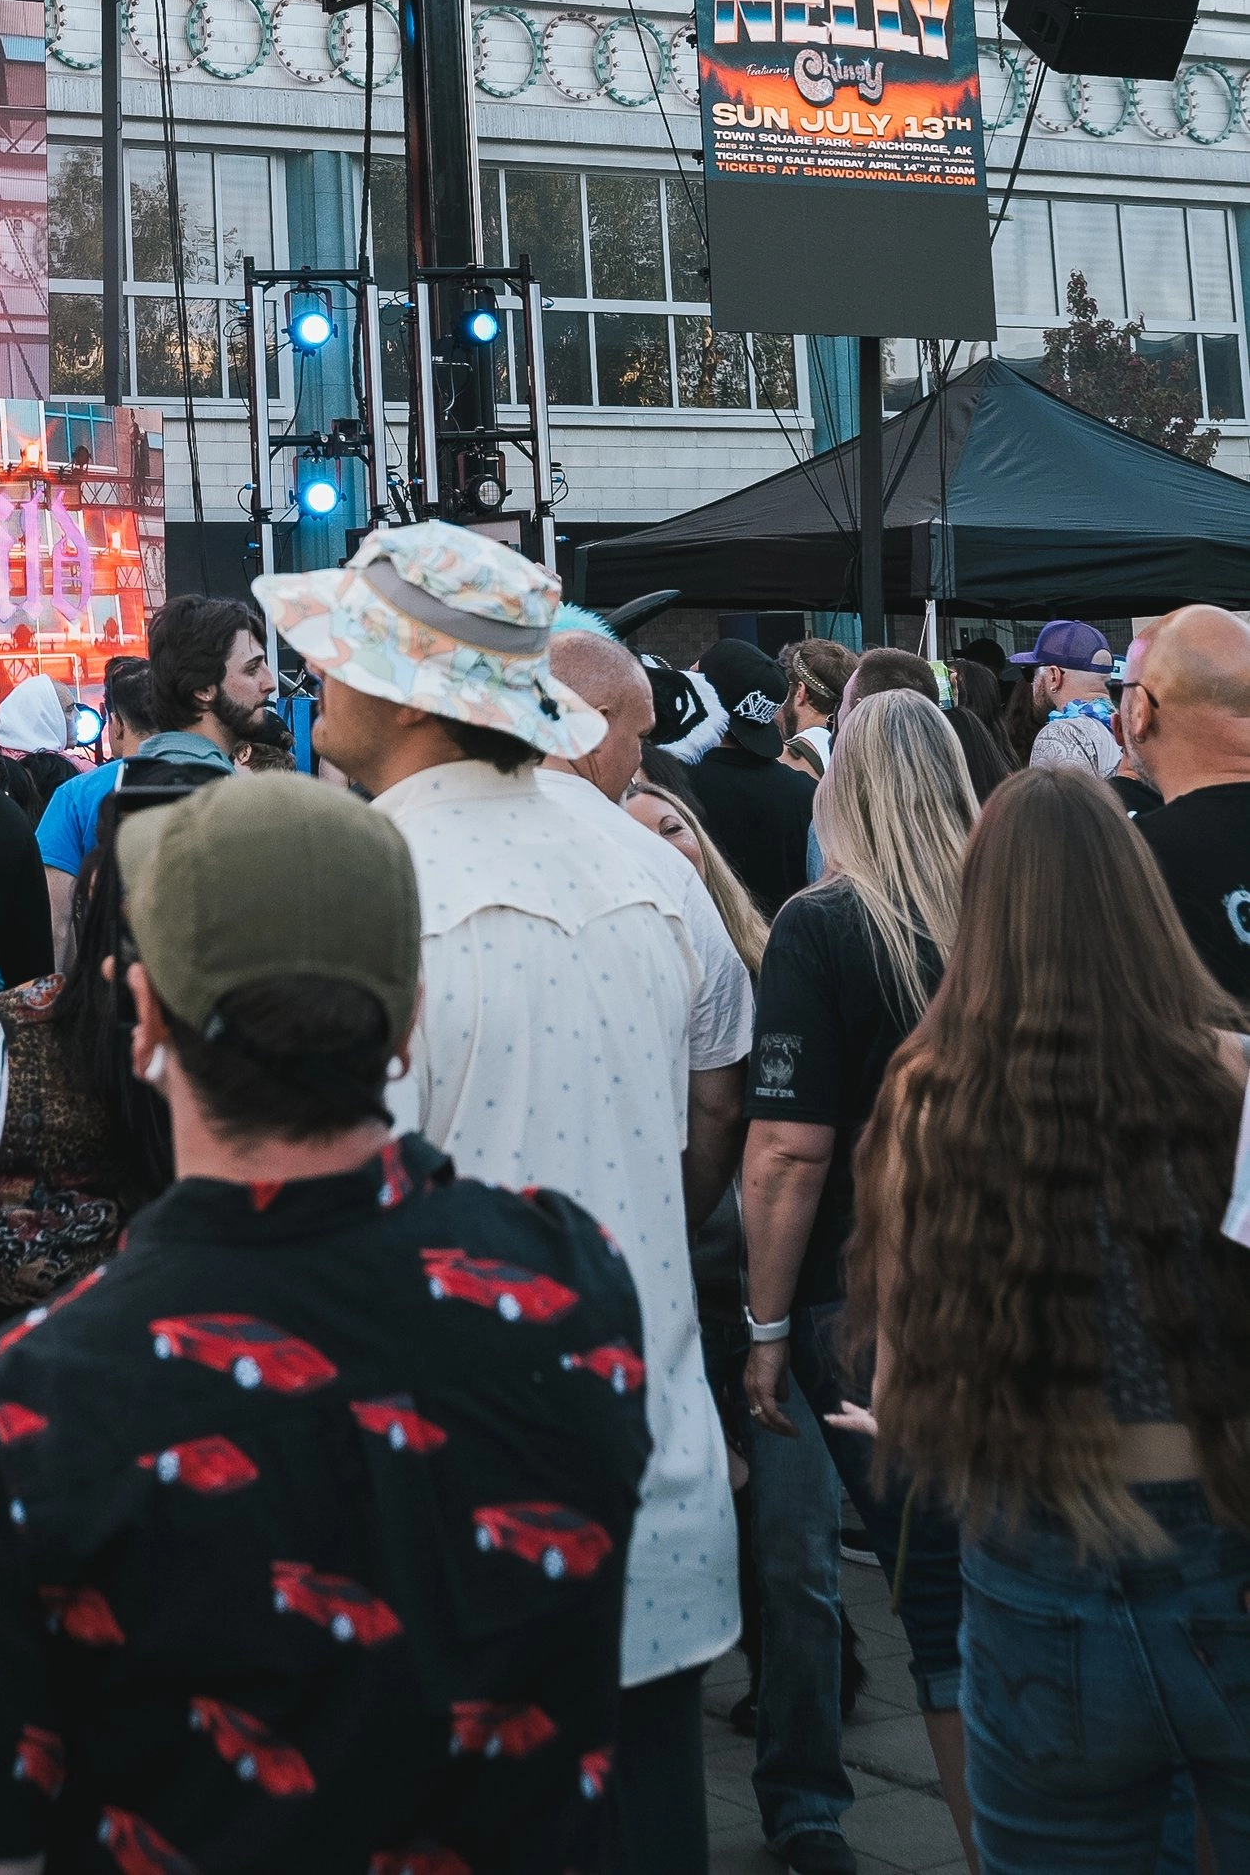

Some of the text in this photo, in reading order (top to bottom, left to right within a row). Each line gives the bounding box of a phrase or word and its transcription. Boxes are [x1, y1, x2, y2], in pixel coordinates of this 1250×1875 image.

[746, 48, 885, 102] Featuring Chingy
[711, 102, 972, 140] SUN JULY 13TH
[713, 130, 755, 142] TOWN
[758, 133, 813, 145] SQUARE
[816, 137, 852, 148] PARK
[867, 140, 951, 156] ANCHORAGE,
[954, 146, 972, 155] AK
[714, 142, 737, 150] AGES
[739, 143, 754, 151] 21+
[820, 150, 867, 158] ACCOMPANIED
[715, 151, 975, 175] TICKETS ON SALE MONDAY APRIL 14TH AT 10AM
[716, 161, 976, 186] TICKETS AT SHOWDOWNALASKA.COM
